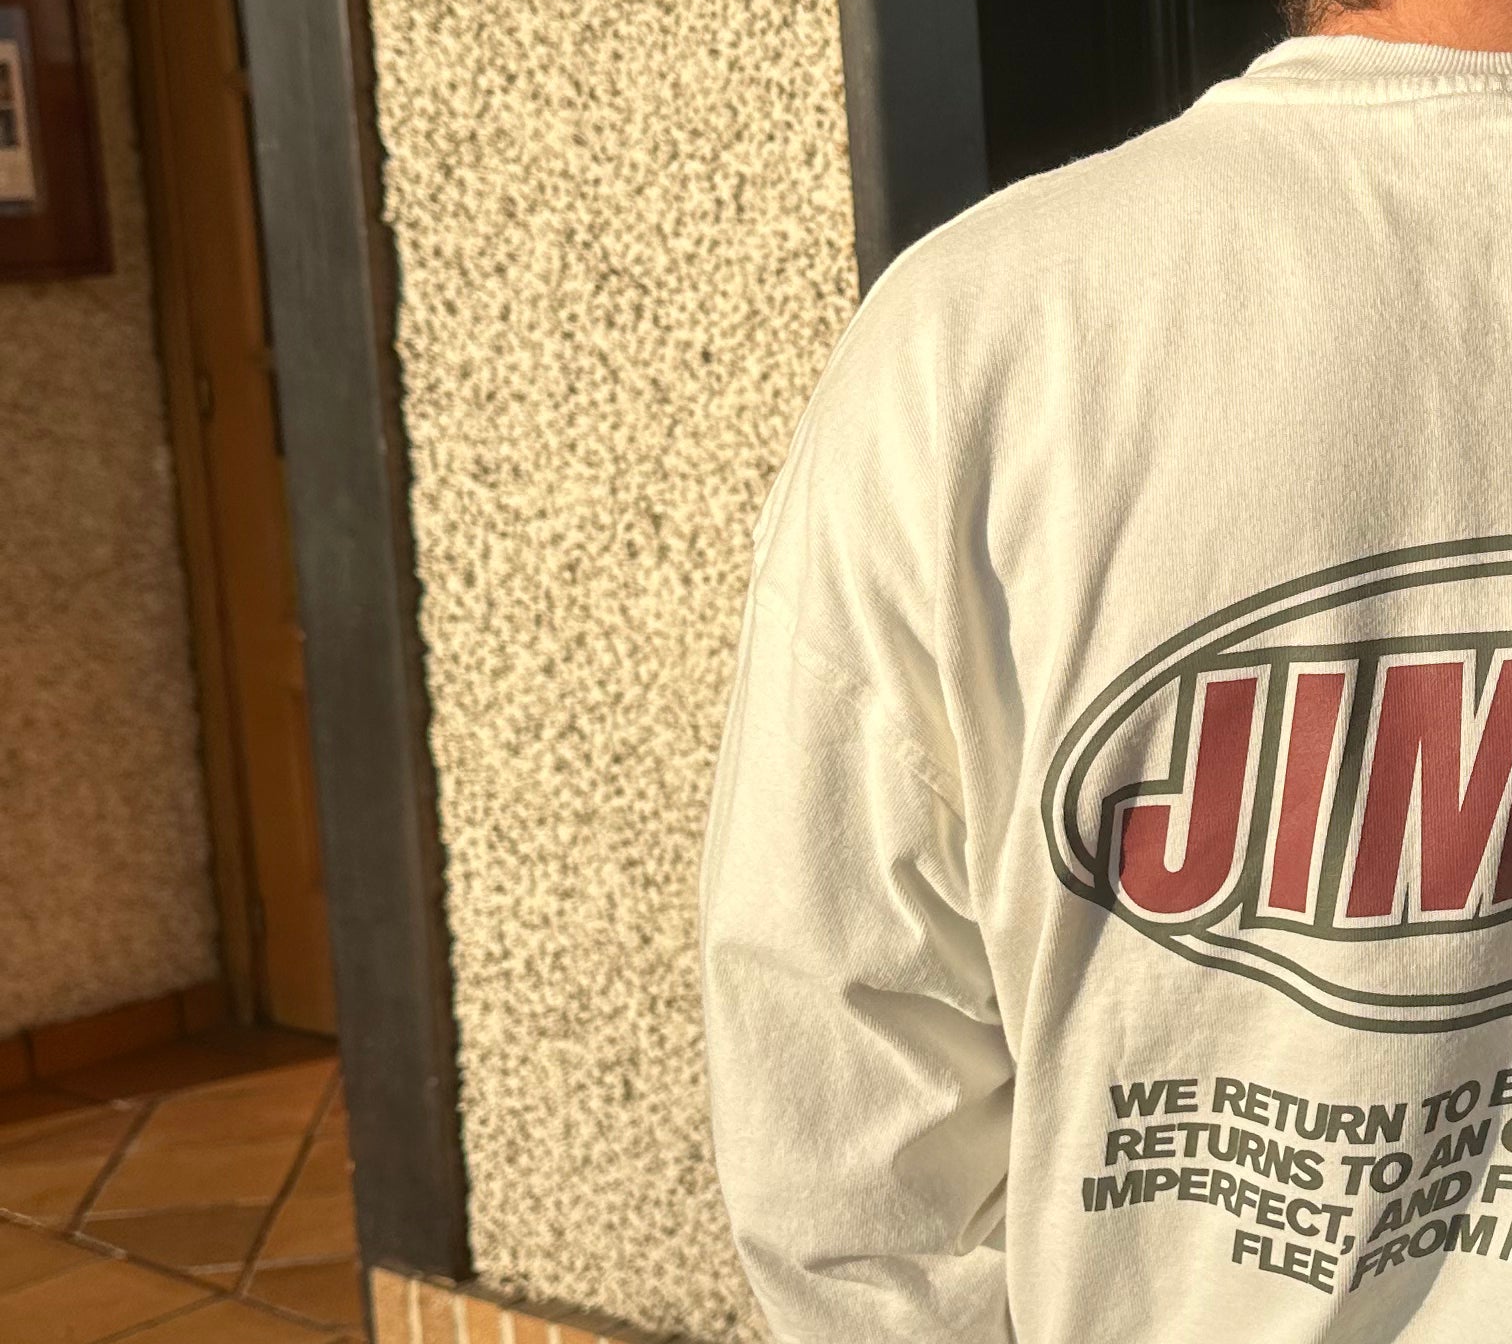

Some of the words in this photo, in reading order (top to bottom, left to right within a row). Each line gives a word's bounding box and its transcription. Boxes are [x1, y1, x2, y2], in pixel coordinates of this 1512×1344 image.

[1110, 1078, 1199, 1119] WE
[1211, 1076, 1408, 1145] RETURN
[1420, 1079, 1481, 1135] TO
[1104, 1121, 1325, 1190] RETURNS
[1340, 1151, 1414, 1196] TO
[1418, 1117, 1492, 1181] AN
[1081, 1166, 1356, 1255] IMPERFECT,
[1366, 1169, 1473, 1244] AND
[1231, 1229, 1339, 1295] FLEE
[1348, 1213, 1498, 1294] FROM
